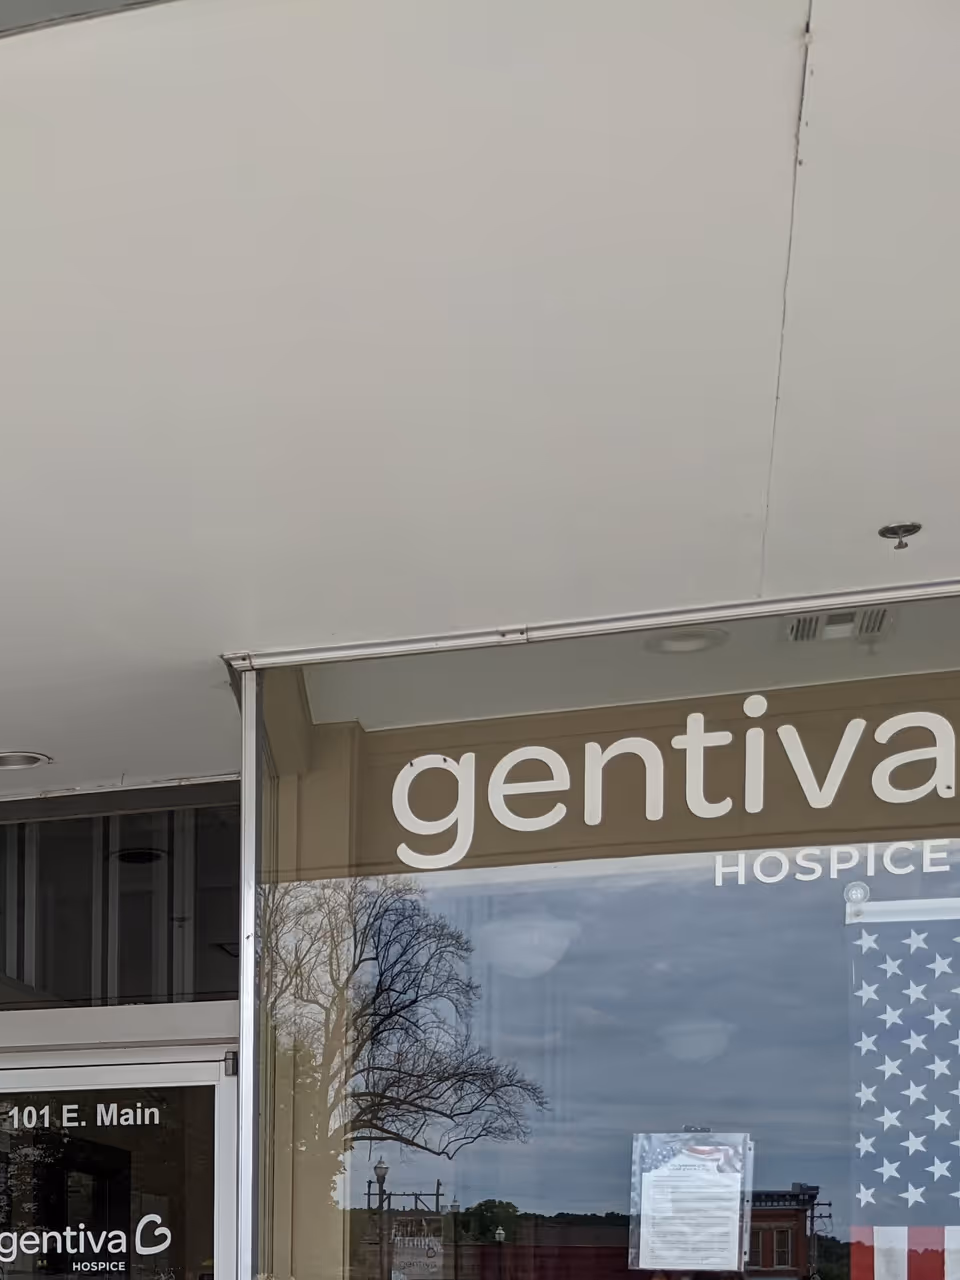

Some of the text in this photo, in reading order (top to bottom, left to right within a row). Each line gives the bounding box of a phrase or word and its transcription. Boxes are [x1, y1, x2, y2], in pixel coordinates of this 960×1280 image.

[392, 695, 957, 869] gentiva
[714, 839, 951, 886] HOSPICE
[8, 1103, 160, 1128] 101 E. Main
[72, 1262, 126, 1272] HOSPICE
